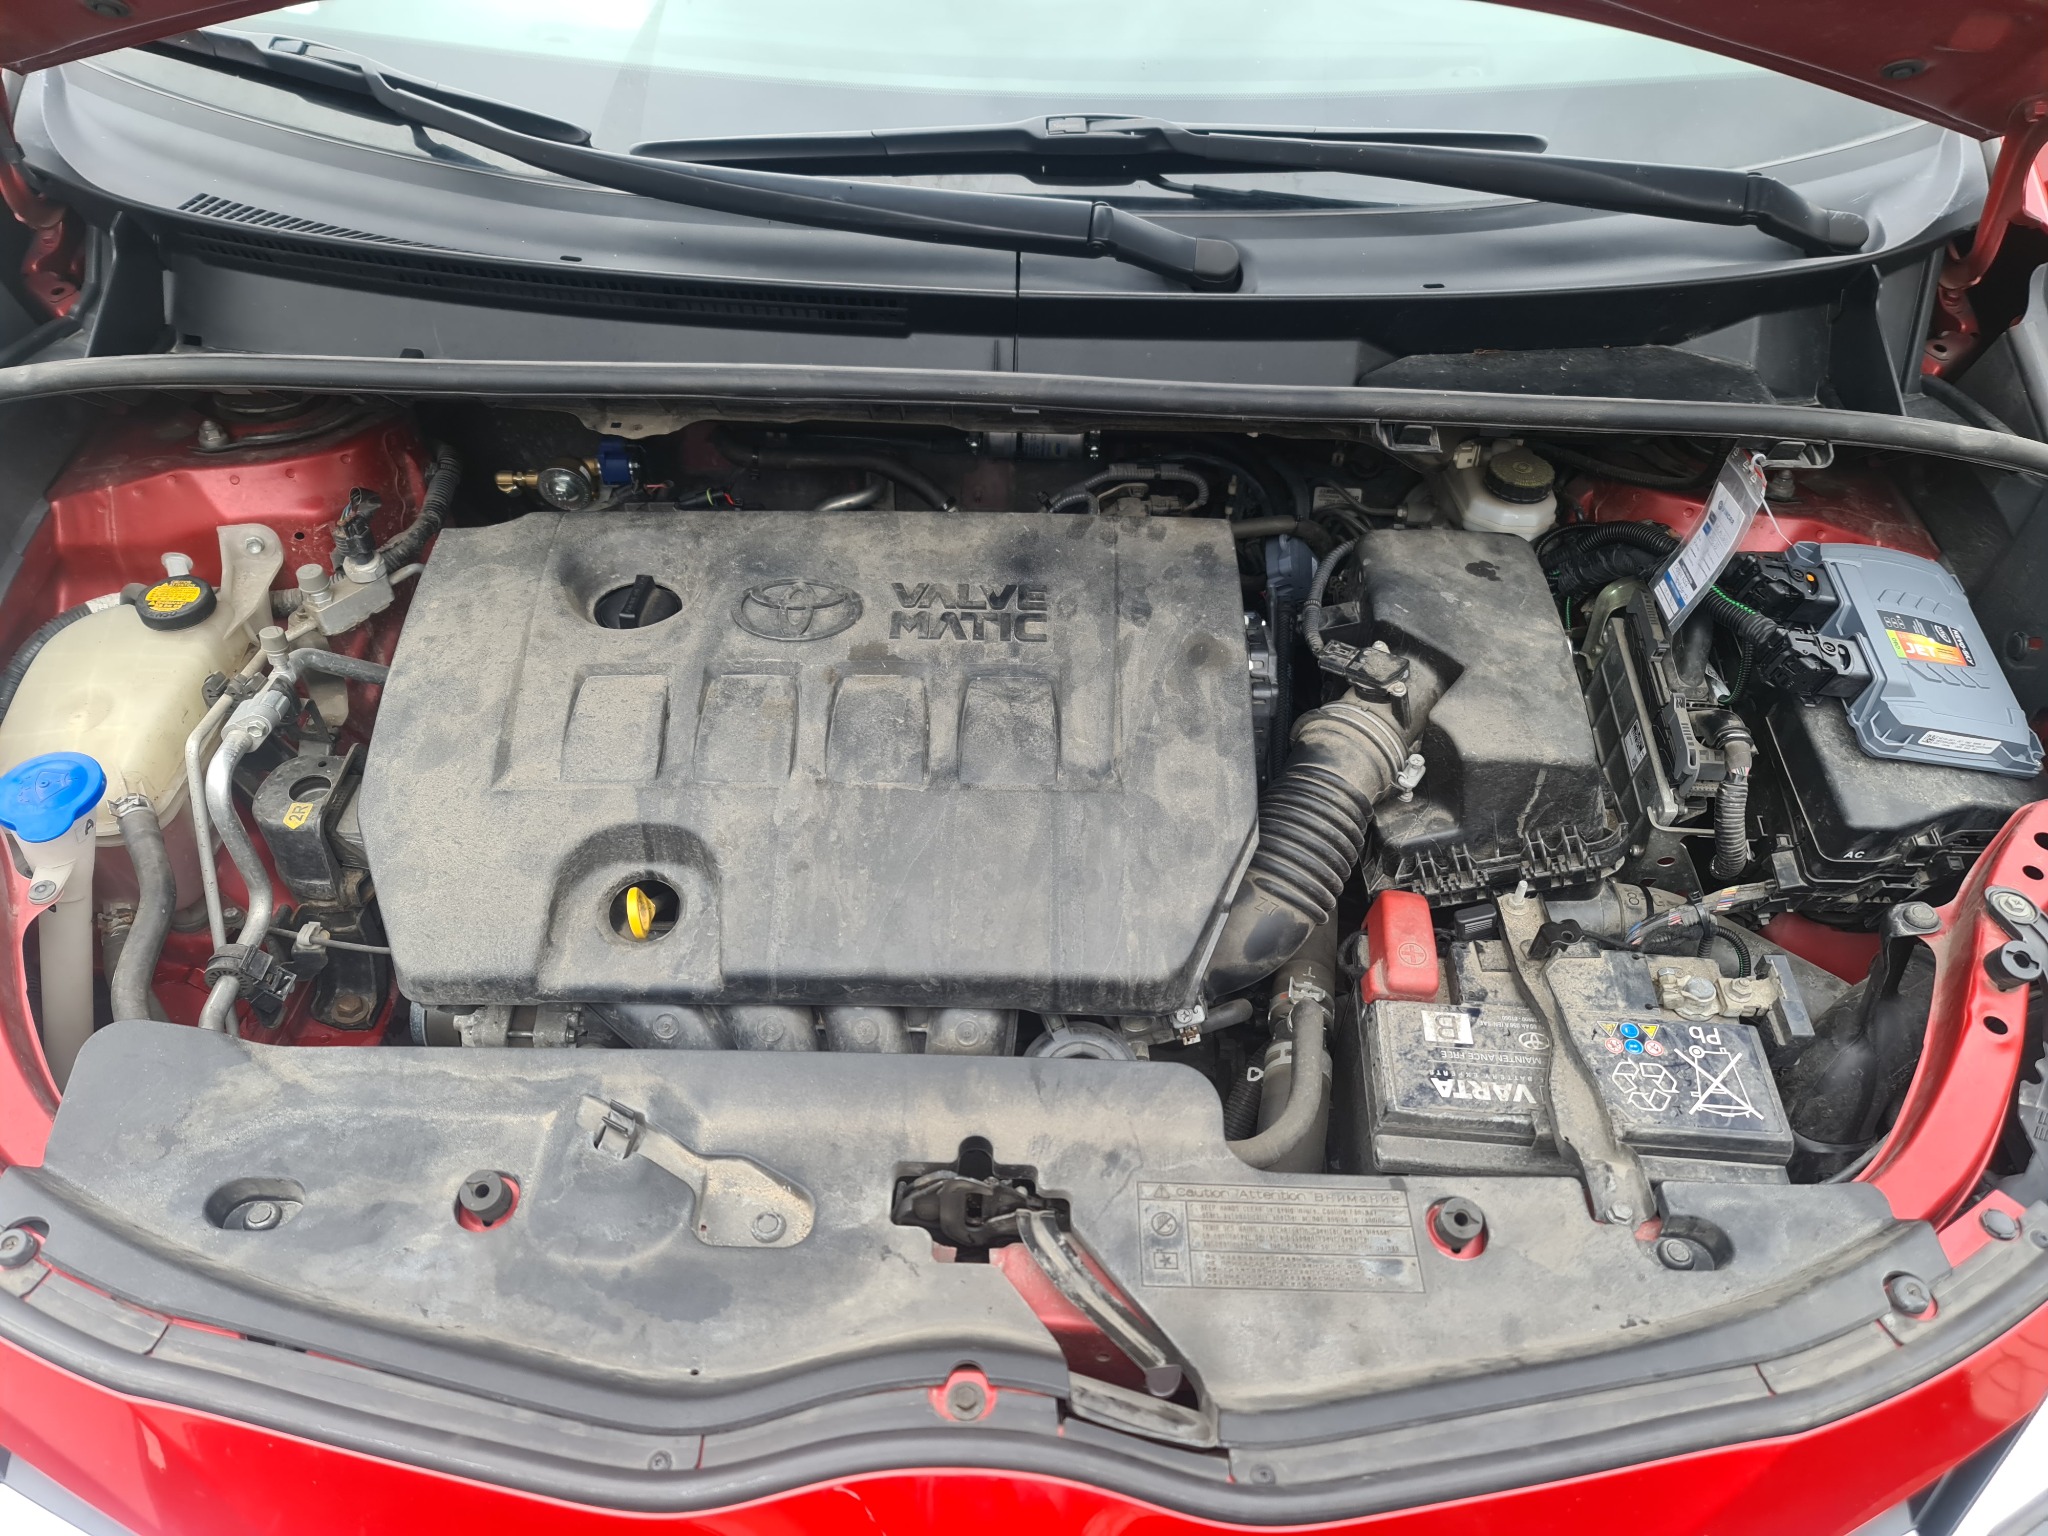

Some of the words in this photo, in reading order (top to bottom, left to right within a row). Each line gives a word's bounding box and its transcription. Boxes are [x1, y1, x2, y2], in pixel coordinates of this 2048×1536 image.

[889, 583, 1047, 611] VALVE
[889, 611, 1047, 642] MATIC
[1906, 642, 1936, 657] JET
[1952, 629, 1975, 666] NEVO-SKY
[289, 805, 309, 821] 2R
[1843, 851, 1865, 859] AC
[1435, 1014, 1459, 1041] B
[1689, 1026, 1721, 1045] Pb
[1431, 1077, 1537, 1104] VARTA
[1176, 1186, 1230, 1199] Caution
[1239, 1189, 1306, 1201] Attention
[1314, 1192, 1400, 1204] Внимание
